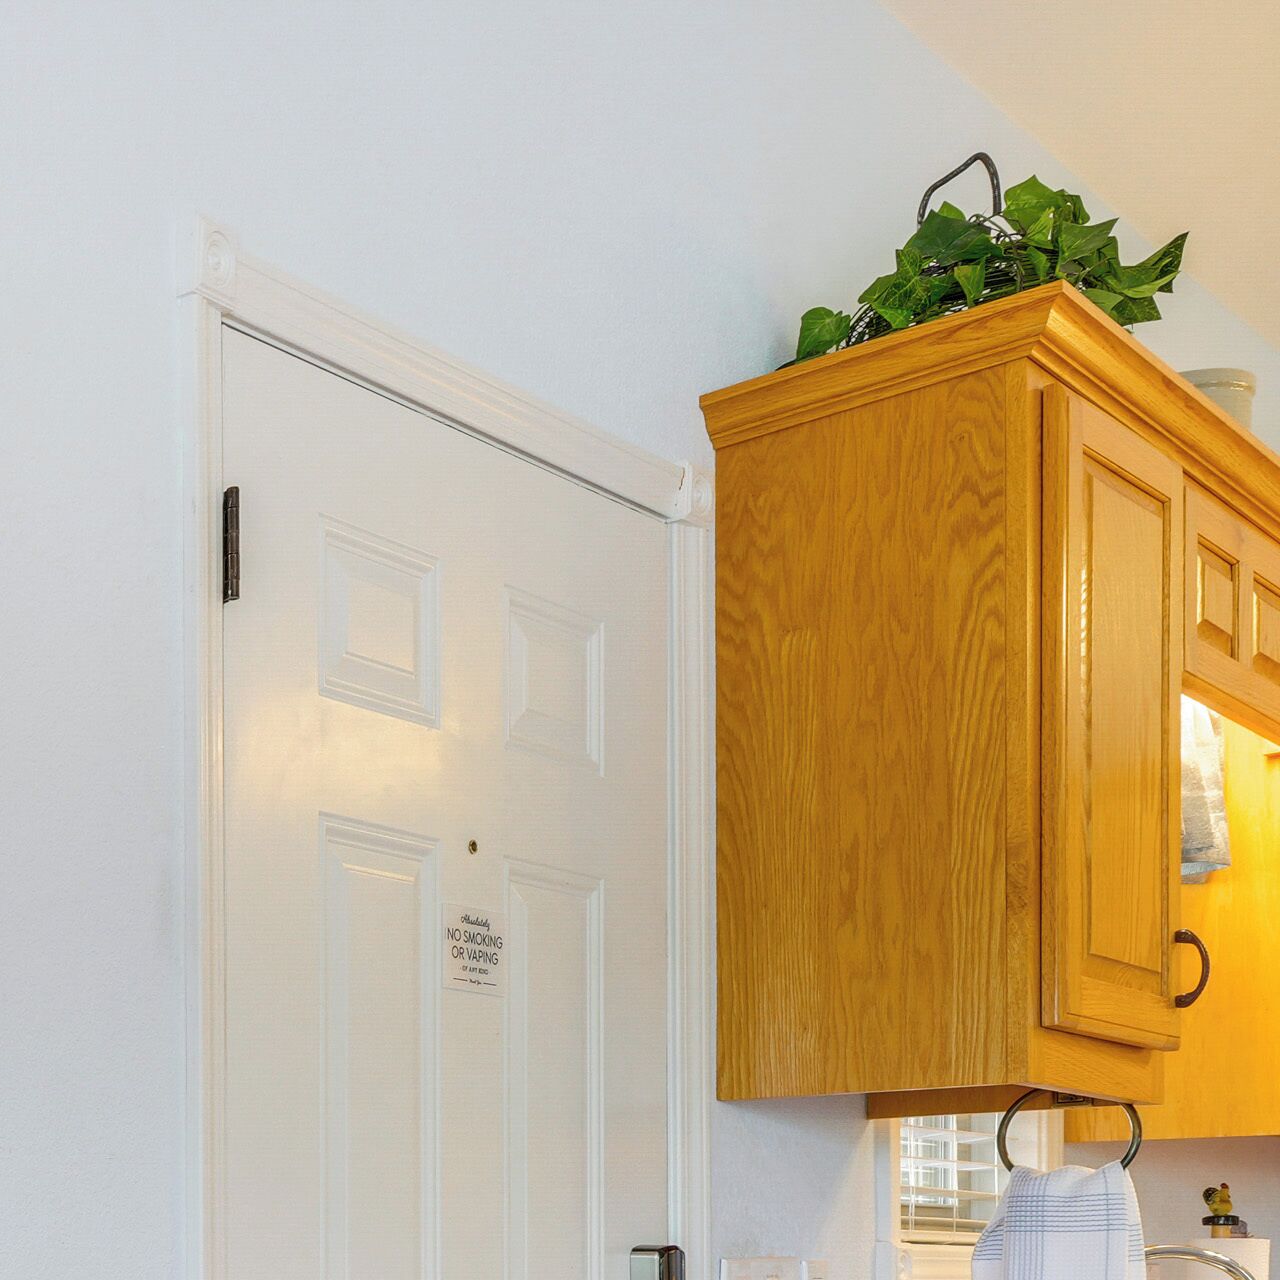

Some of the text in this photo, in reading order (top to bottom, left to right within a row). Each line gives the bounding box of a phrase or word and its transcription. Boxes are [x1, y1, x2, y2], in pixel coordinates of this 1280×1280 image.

[447, 928, 503, 949] NO SMOKING
[451, 945, 499, 966] OR VAPING
